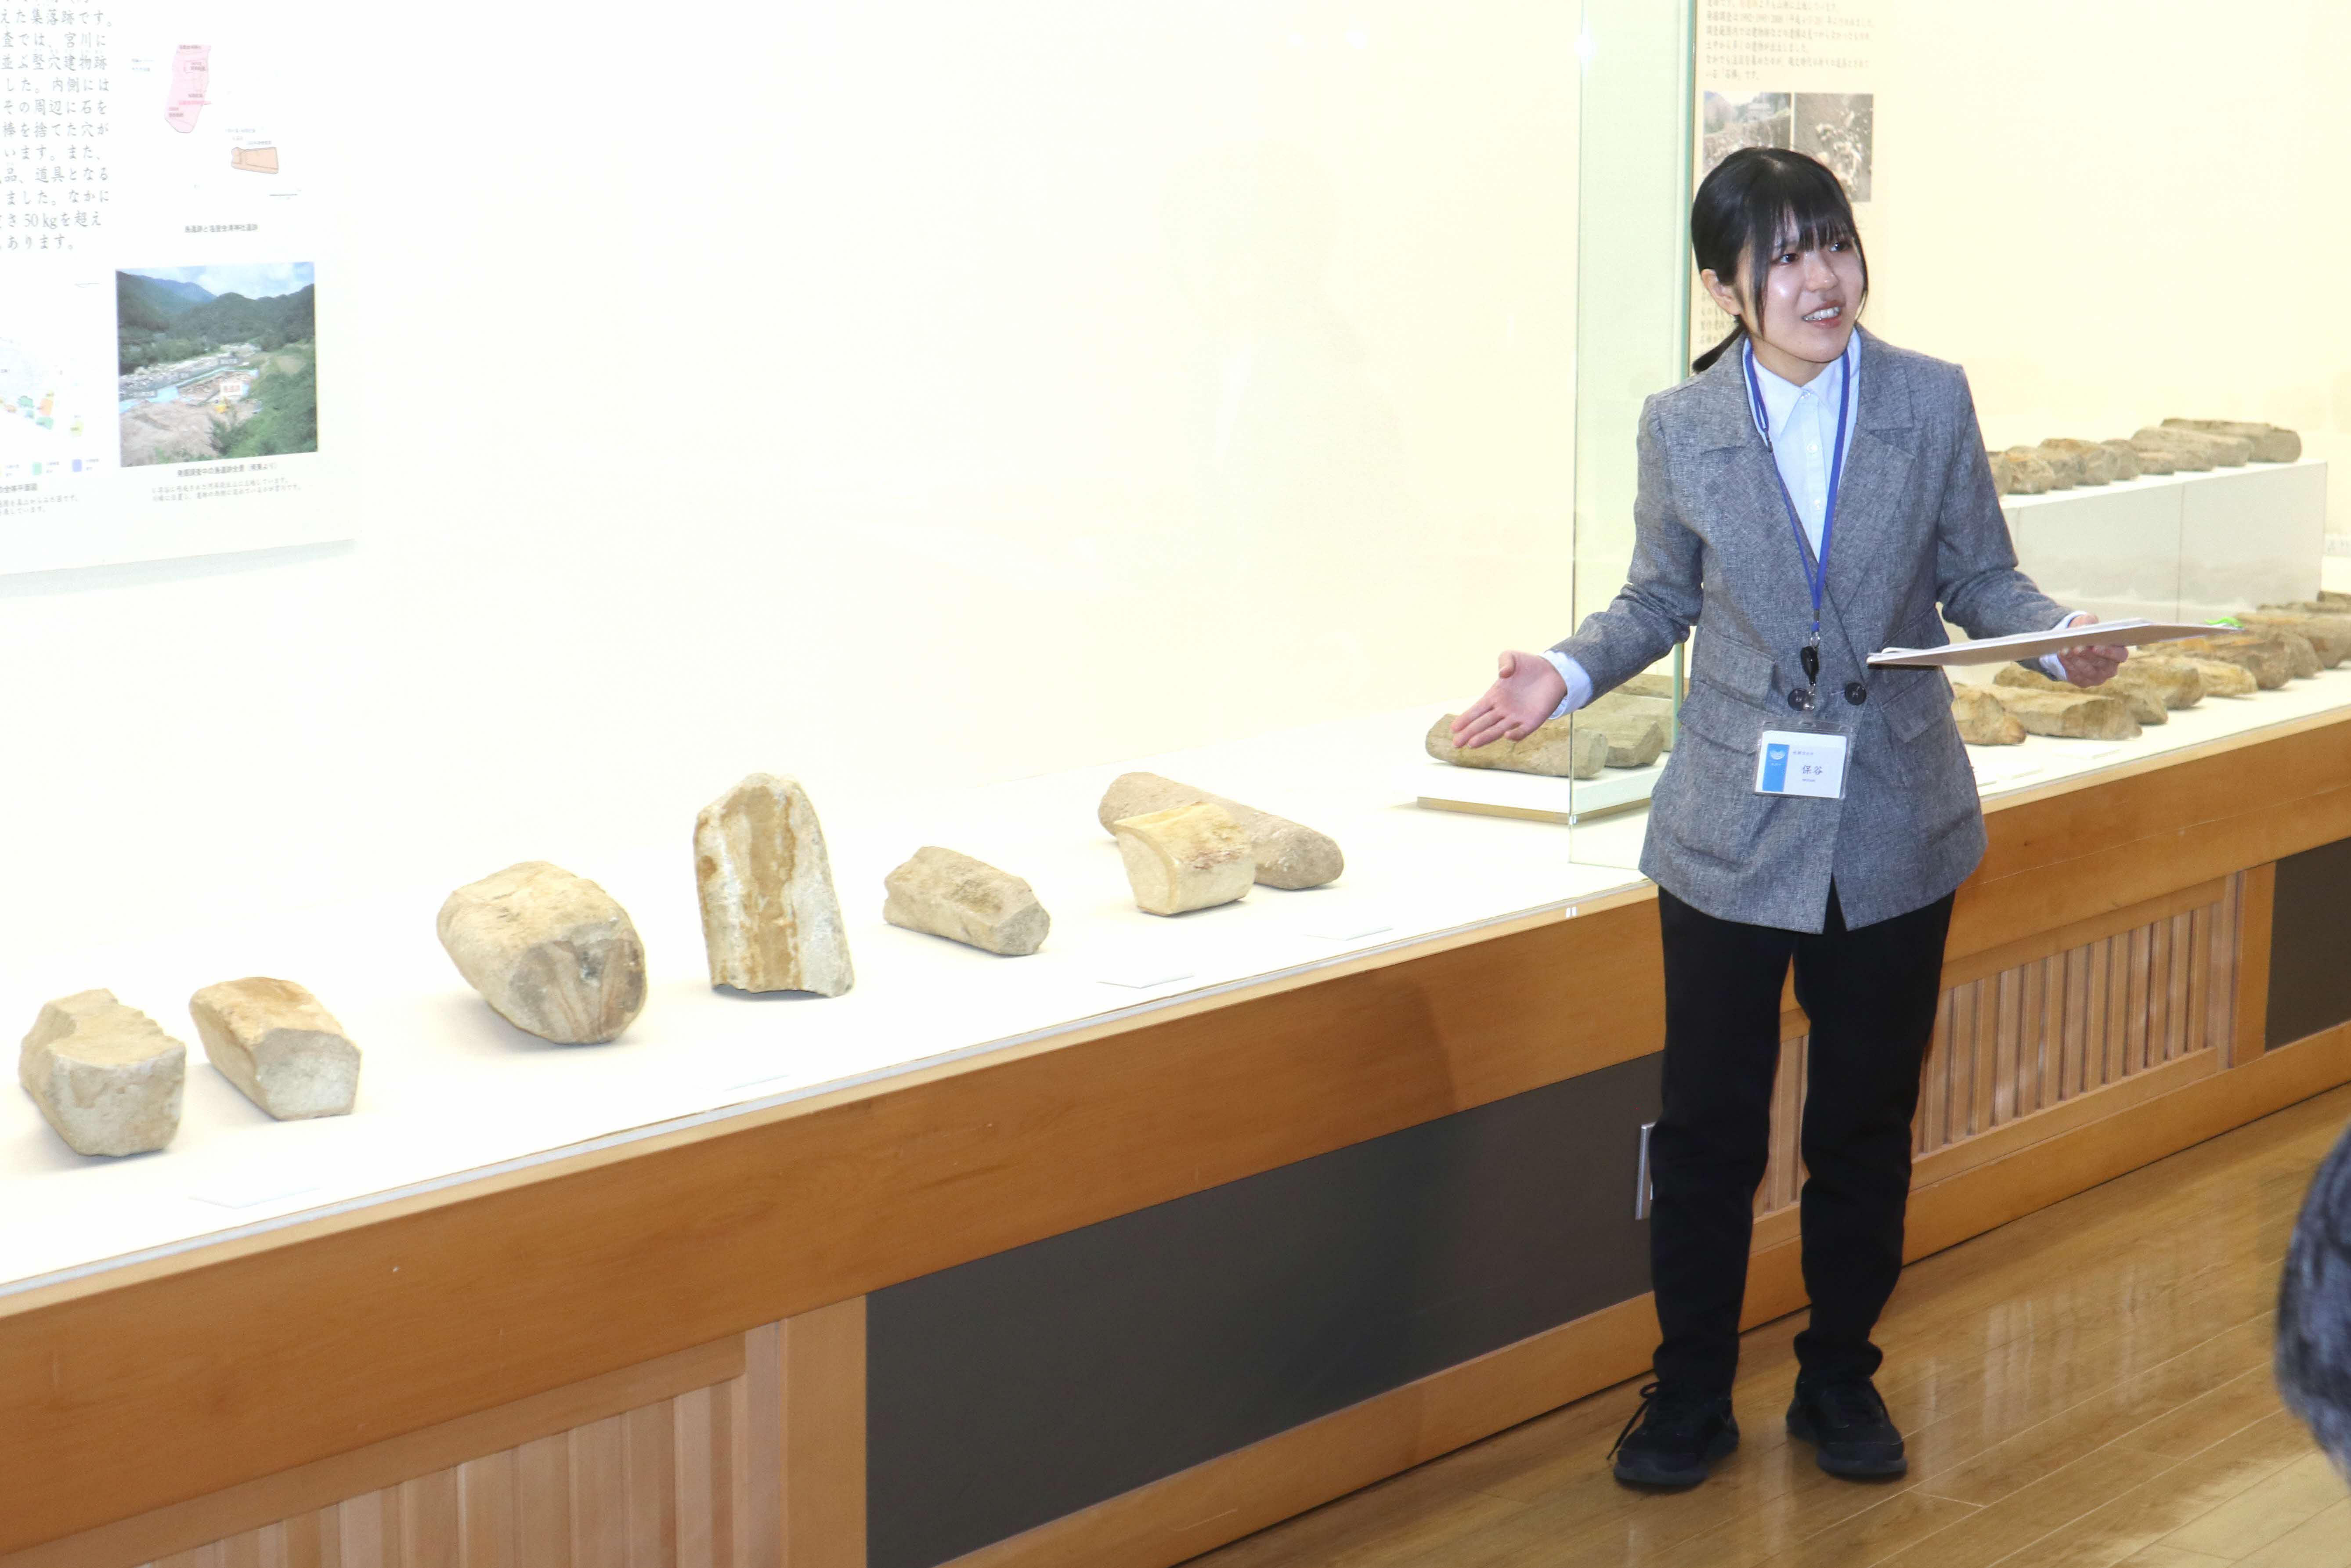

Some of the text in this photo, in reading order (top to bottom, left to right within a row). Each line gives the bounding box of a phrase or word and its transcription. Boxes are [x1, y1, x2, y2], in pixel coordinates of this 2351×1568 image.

[0, 8, 112, 28] えた集落跡です。
[4, 98, 107, 115] その周辺に石を
[2, 121, 109, 138] 棒を捨てた穴が
[0, 166, 109, 183] 品、道具となる
[7, 189, 109, 206] ました。なかに
[0, 234, 74, 250] あります。
[1802, 764, 1823, 775] 保谷
